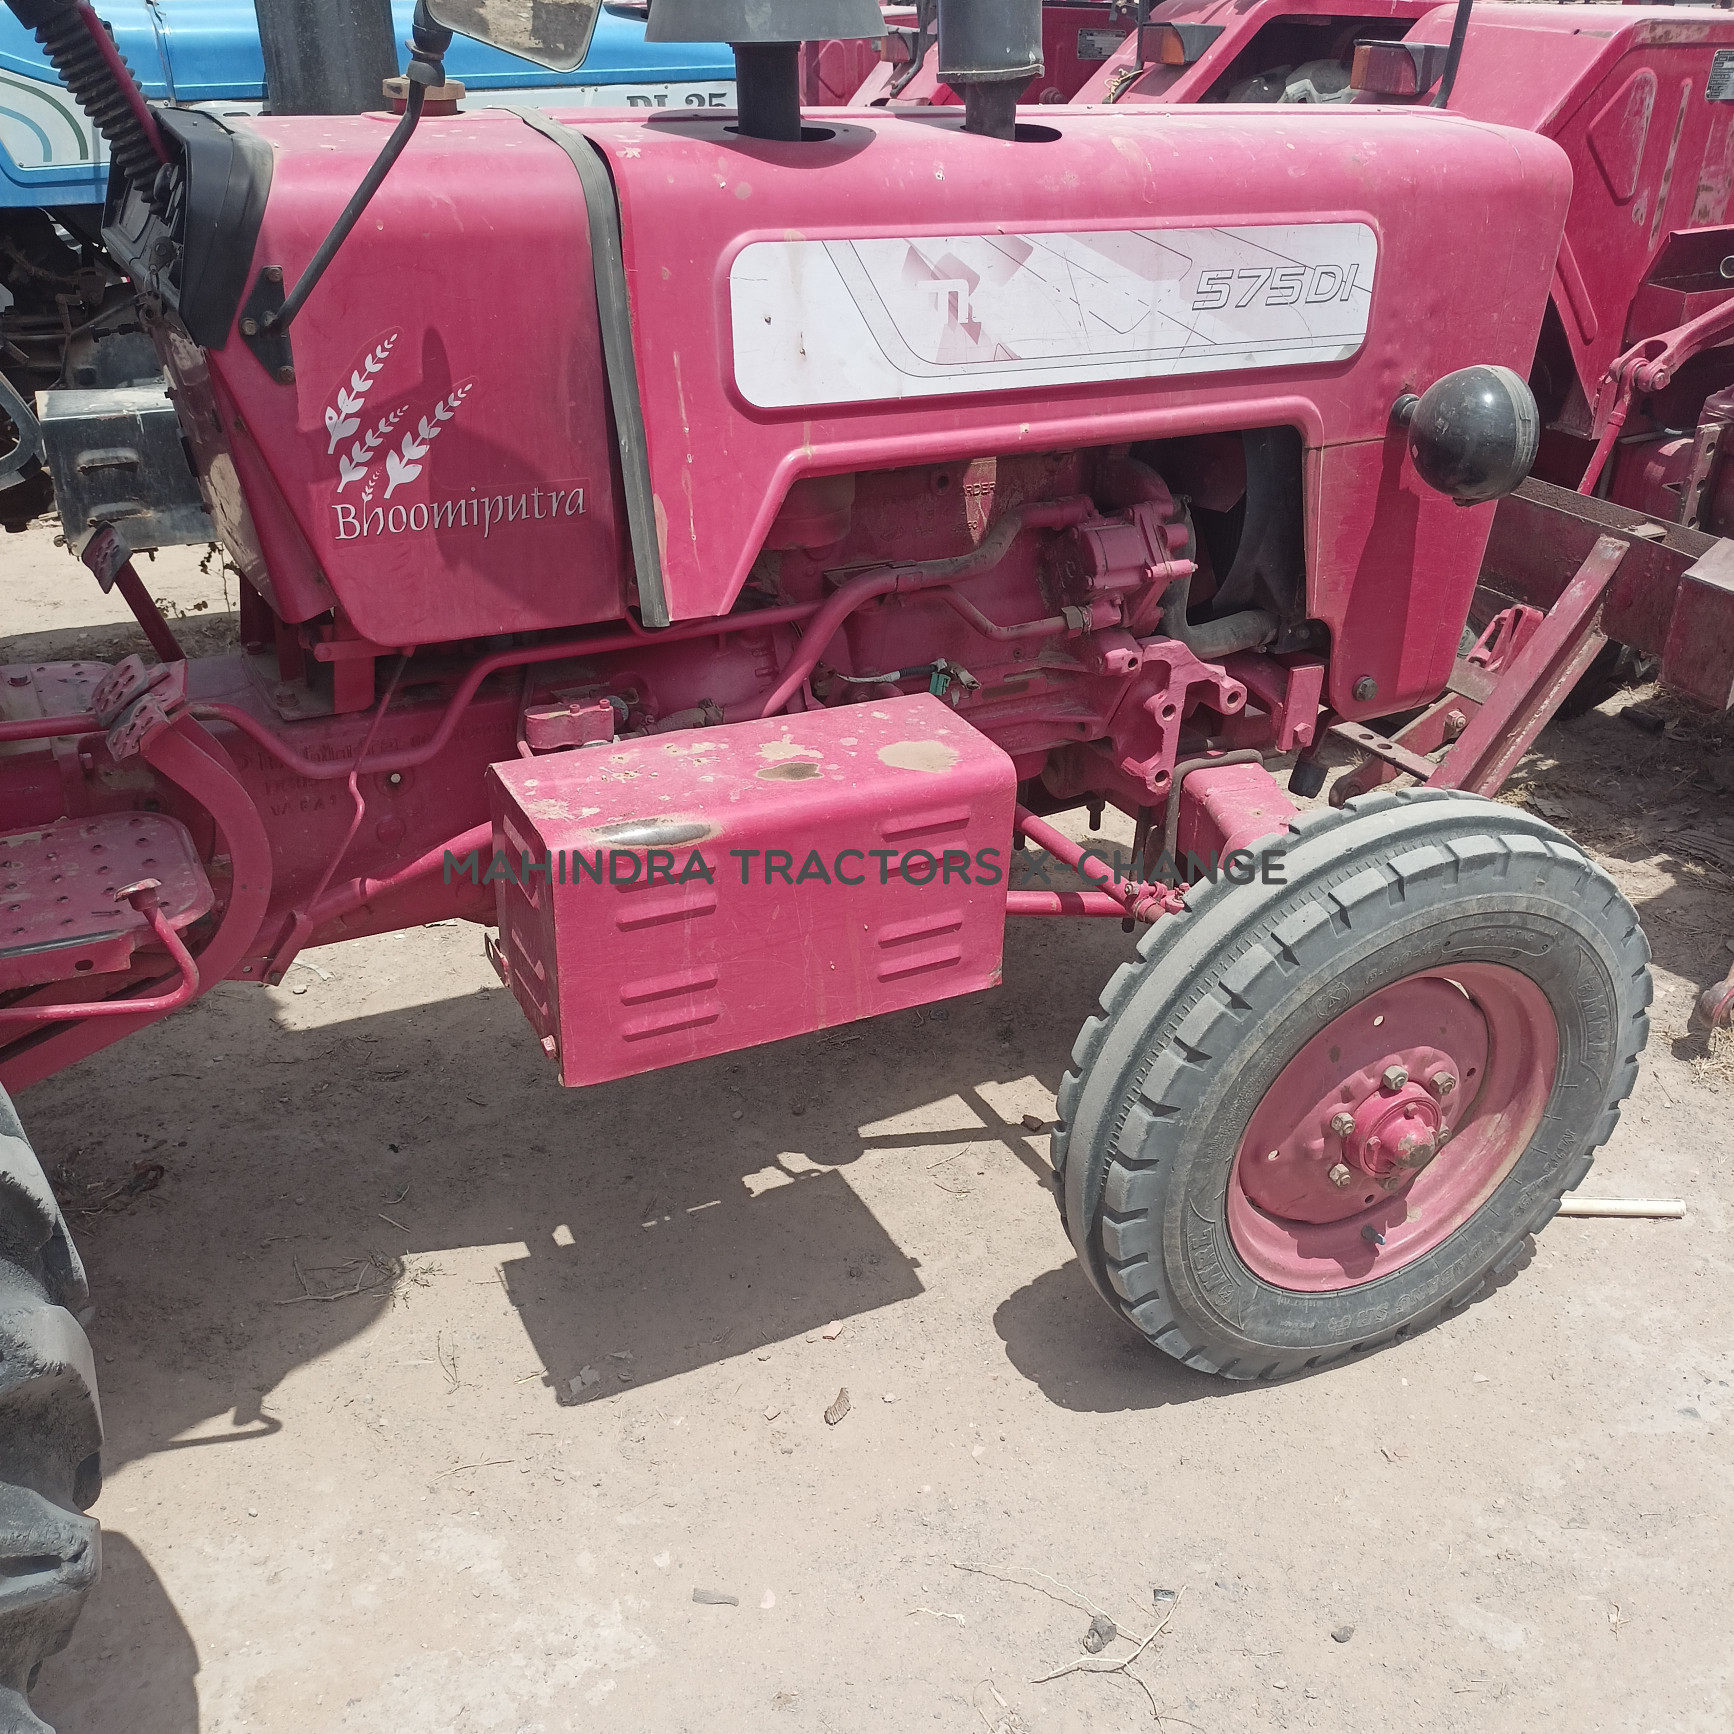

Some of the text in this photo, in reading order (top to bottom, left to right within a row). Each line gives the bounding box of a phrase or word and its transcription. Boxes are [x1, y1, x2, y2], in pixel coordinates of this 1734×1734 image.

[1192, 264, 1359, 311] 575DI
[331, 487, 587, 540] Bhoomiputra
[1189, 1227, 1233, 1292] MRF
